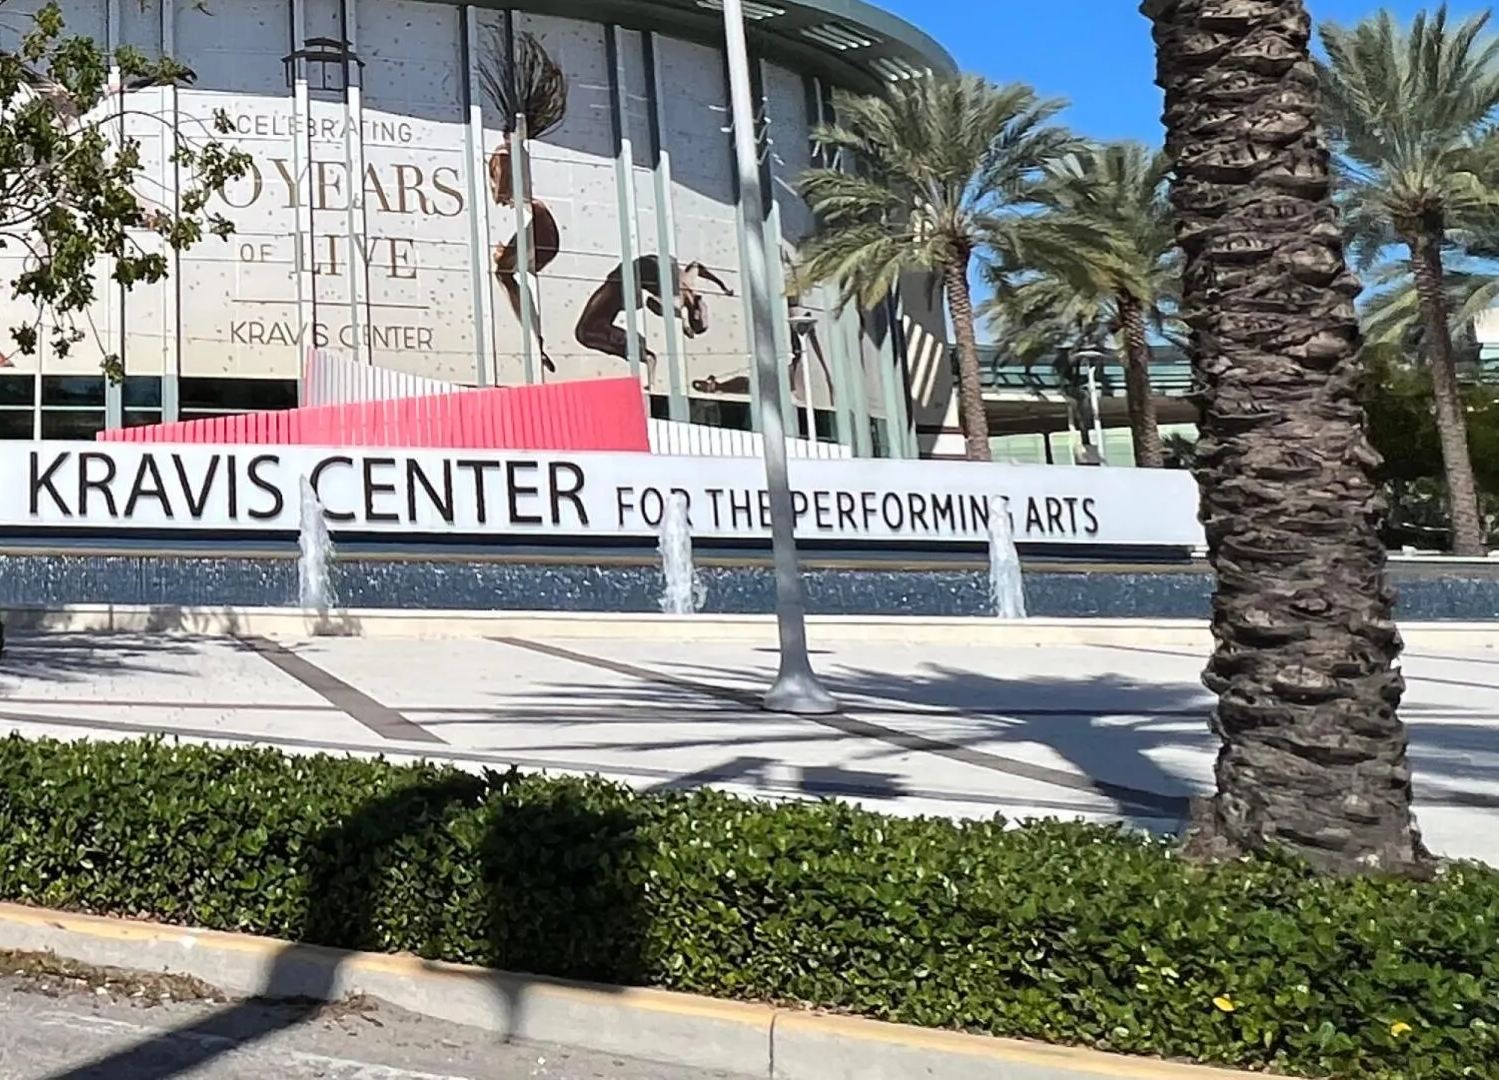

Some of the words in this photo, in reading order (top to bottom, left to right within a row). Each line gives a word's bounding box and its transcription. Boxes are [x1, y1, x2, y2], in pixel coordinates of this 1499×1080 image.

[266, 157, 465, 217] YEARS
[240, 242, 273, 263] OF
[288, 231, 418, 280] LIVE
[229, 320, 329, 349] KRAVS
[338, 323, 435, 351] CENTER
[29, 451, 284, 520] KRAVIS
[309, 455, 589, 525] CENTER
[704, 488, 773, 529] THE
[789, 490, 1015, 535] PERFORMIN
[1025, 496, 1099, 536] ARTS
